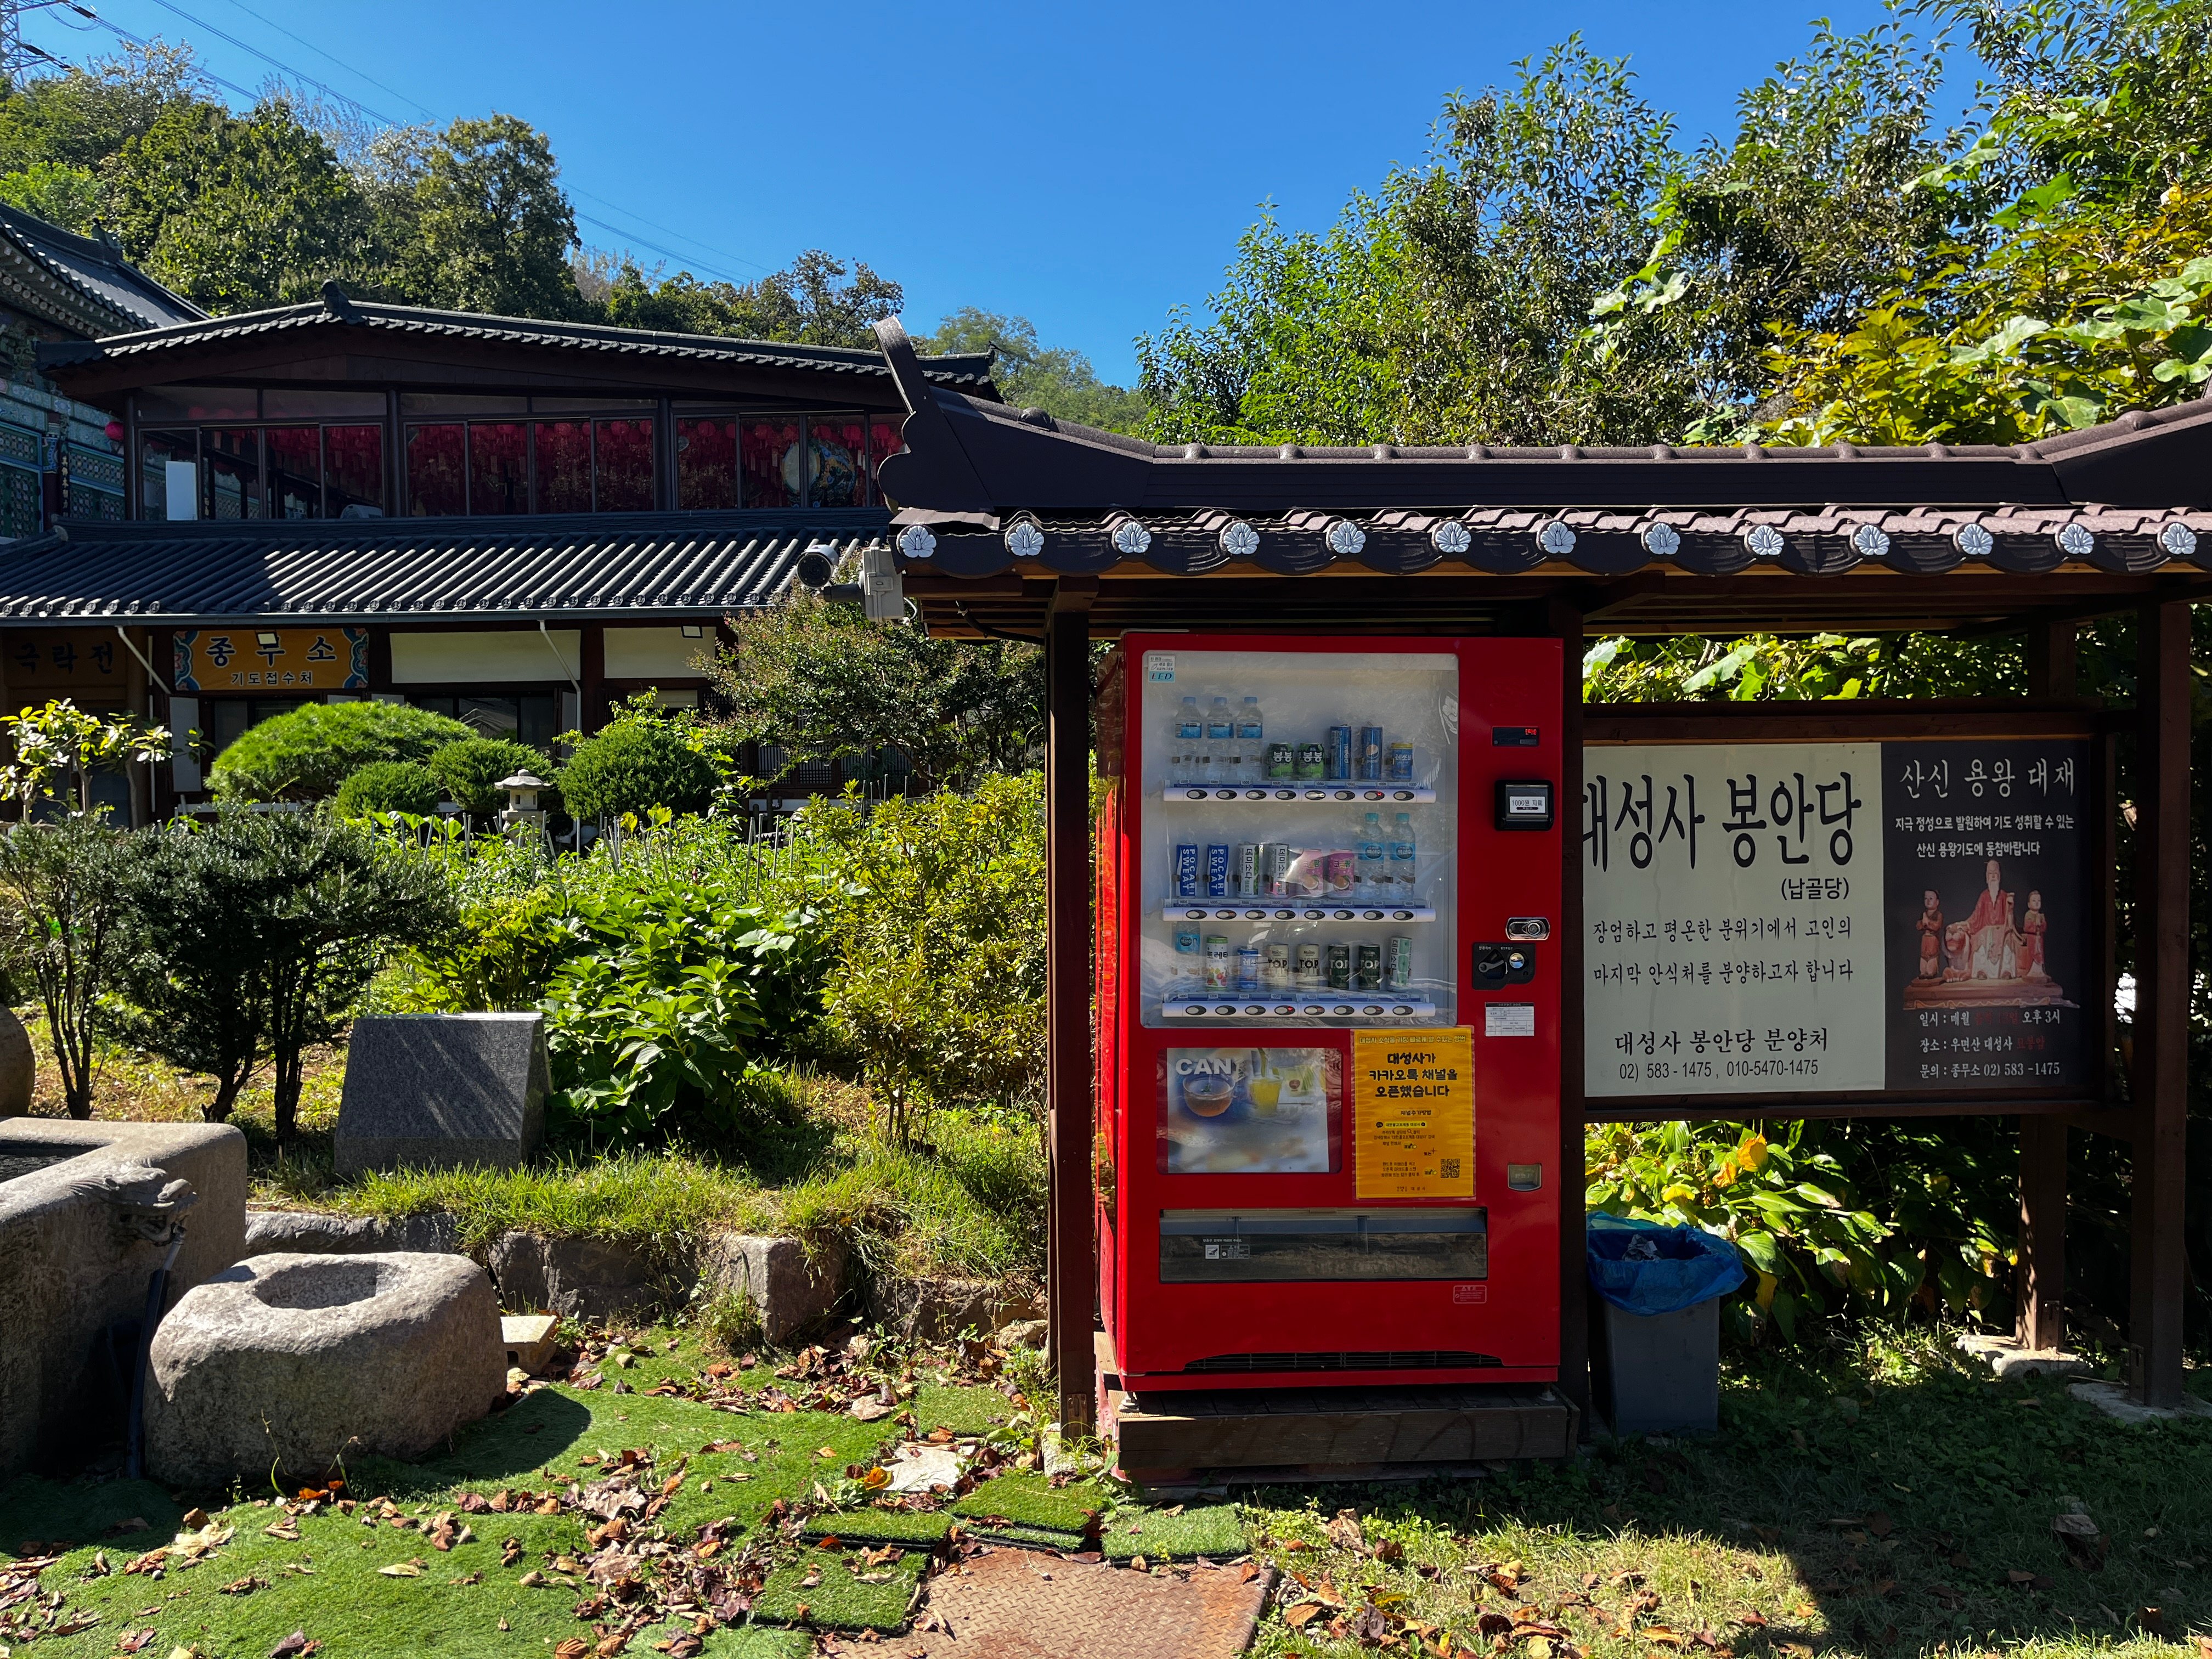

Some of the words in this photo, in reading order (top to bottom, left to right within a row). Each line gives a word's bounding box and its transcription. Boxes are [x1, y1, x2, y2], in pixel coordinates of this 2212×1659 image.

[15, 641, 114, 674] 극락전
[206, 635, 336, 668] 종무소
[232, 672, 313, 685] 기도접수처
[1900, 759, 1948, 799] 산신
[1964, 758, 2016, 798] 용왕
[2028, 758, 2074, 796] 대재
[1722, 771, 1862, 868] 봉안당
[1895, 817, 1914, 832] 지극
[1916, 816, 1954, 832] 정성으로
[1956, 815, 1991, 831] 발원하여
[1994, 815, 2013, 830] 기도
[2015, 814, 2042, 831] 성취할
[2045, 815, 2055, 829] 수
[2056, 814, 2074, 829] 있는
[1916, 843, 1936, 858] 산신
[1938, 842, 1983, 858] 용왕기도에
[1985, 841, 2040, 857] 동참바랍니다
[1245, 848, 1253, 879] 데미소다
[1781, 877, 1849, 901] (납골당)
[1593, 919, 1657, 944] 장엄하고
[1664, 918, 1712, 943] 평온한
[1718, 917, 1796, 941] 분위기에서
[1805, 916, 1850, 939] 고인의
[1594, 963, 1641, 986] 마지막
[1649, 962, 1712, 986] 안식처를
[1719, 960, 1798, 984] 분양하고자
[1805, 958, 1853, 983] 합니다
[1920, 1011, 1938, 1027] 일시
[1950, 1011, 1970, 1026] 매월
[2022, 1009, 2042, 1024] 오후
[2045, 1009, 2060, 1024] 3시
[1615, 1030, 1681, 1056] 대성사
[1689, 1029, 1756, 1054] 봉안당
[1764, 1027, 1827, 1052] 분양처
[1920, 1037, 1940, 1053] 장소
[1950, 1036, 1980, 1052] 우면산
[1984, 1036, 2013, 1052] 대성사
[1176, 1058, 1232, 1075] CAN
[1387, 1052, 1436, 1065] 대성사가
[1369, 1069, 1419, 1081] 카카오톡
[1421, 1068, 1458, 1081] 채널을
[1620, 1063, 1639, 1083] 02)
[1726, 1059, 1818, 1076] 010-5470-1475
[1920, 1063, 1939, 1079] 문의
[1950, 1063, 1980, 1078] 종무소
[1983, 1063, 2000, 1076] 02)
[2004, 1063, 2024, 1076] 583
[1375, 1085, 1450, 1098] 오픈했습니다
